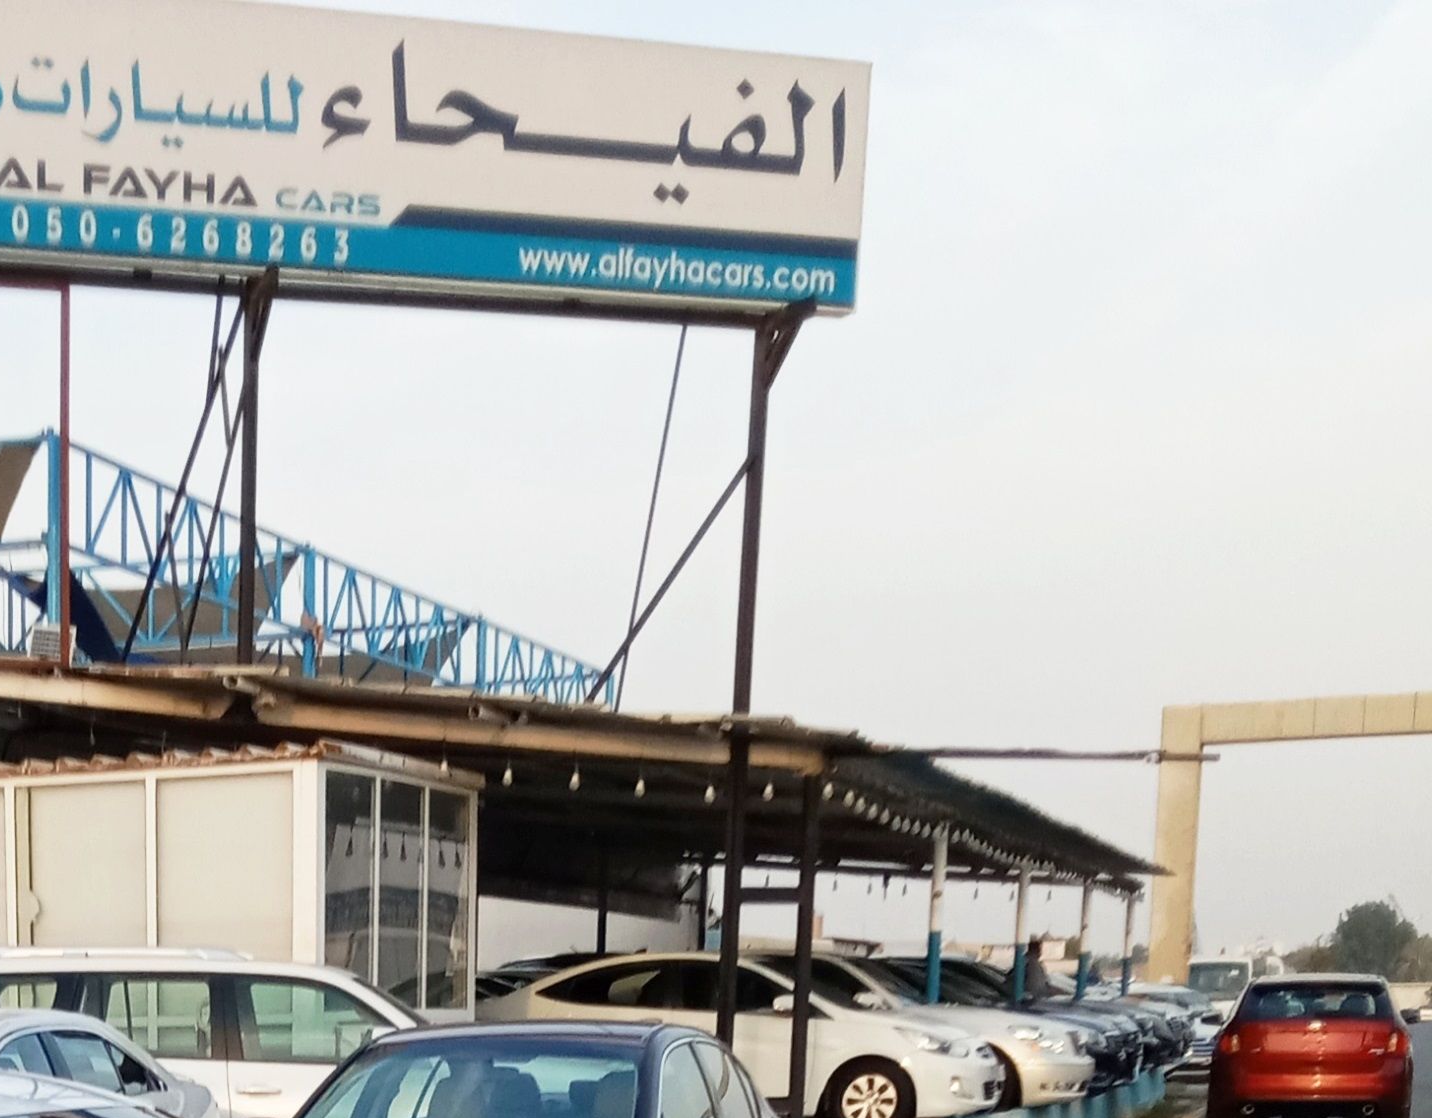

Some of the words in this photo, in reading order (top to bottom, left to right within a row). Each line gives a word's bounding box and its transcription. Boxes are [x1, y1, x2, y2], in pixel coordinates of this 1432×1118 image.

[12, 55, 304, 150] للسيارات
[321, 38, 846, 205] الفيحاء
[82, 162, 258, 208] FAYHA
[275, 187, 381, 217] CARS
[518, 242, 836, 297] www.alfayhacars.com
